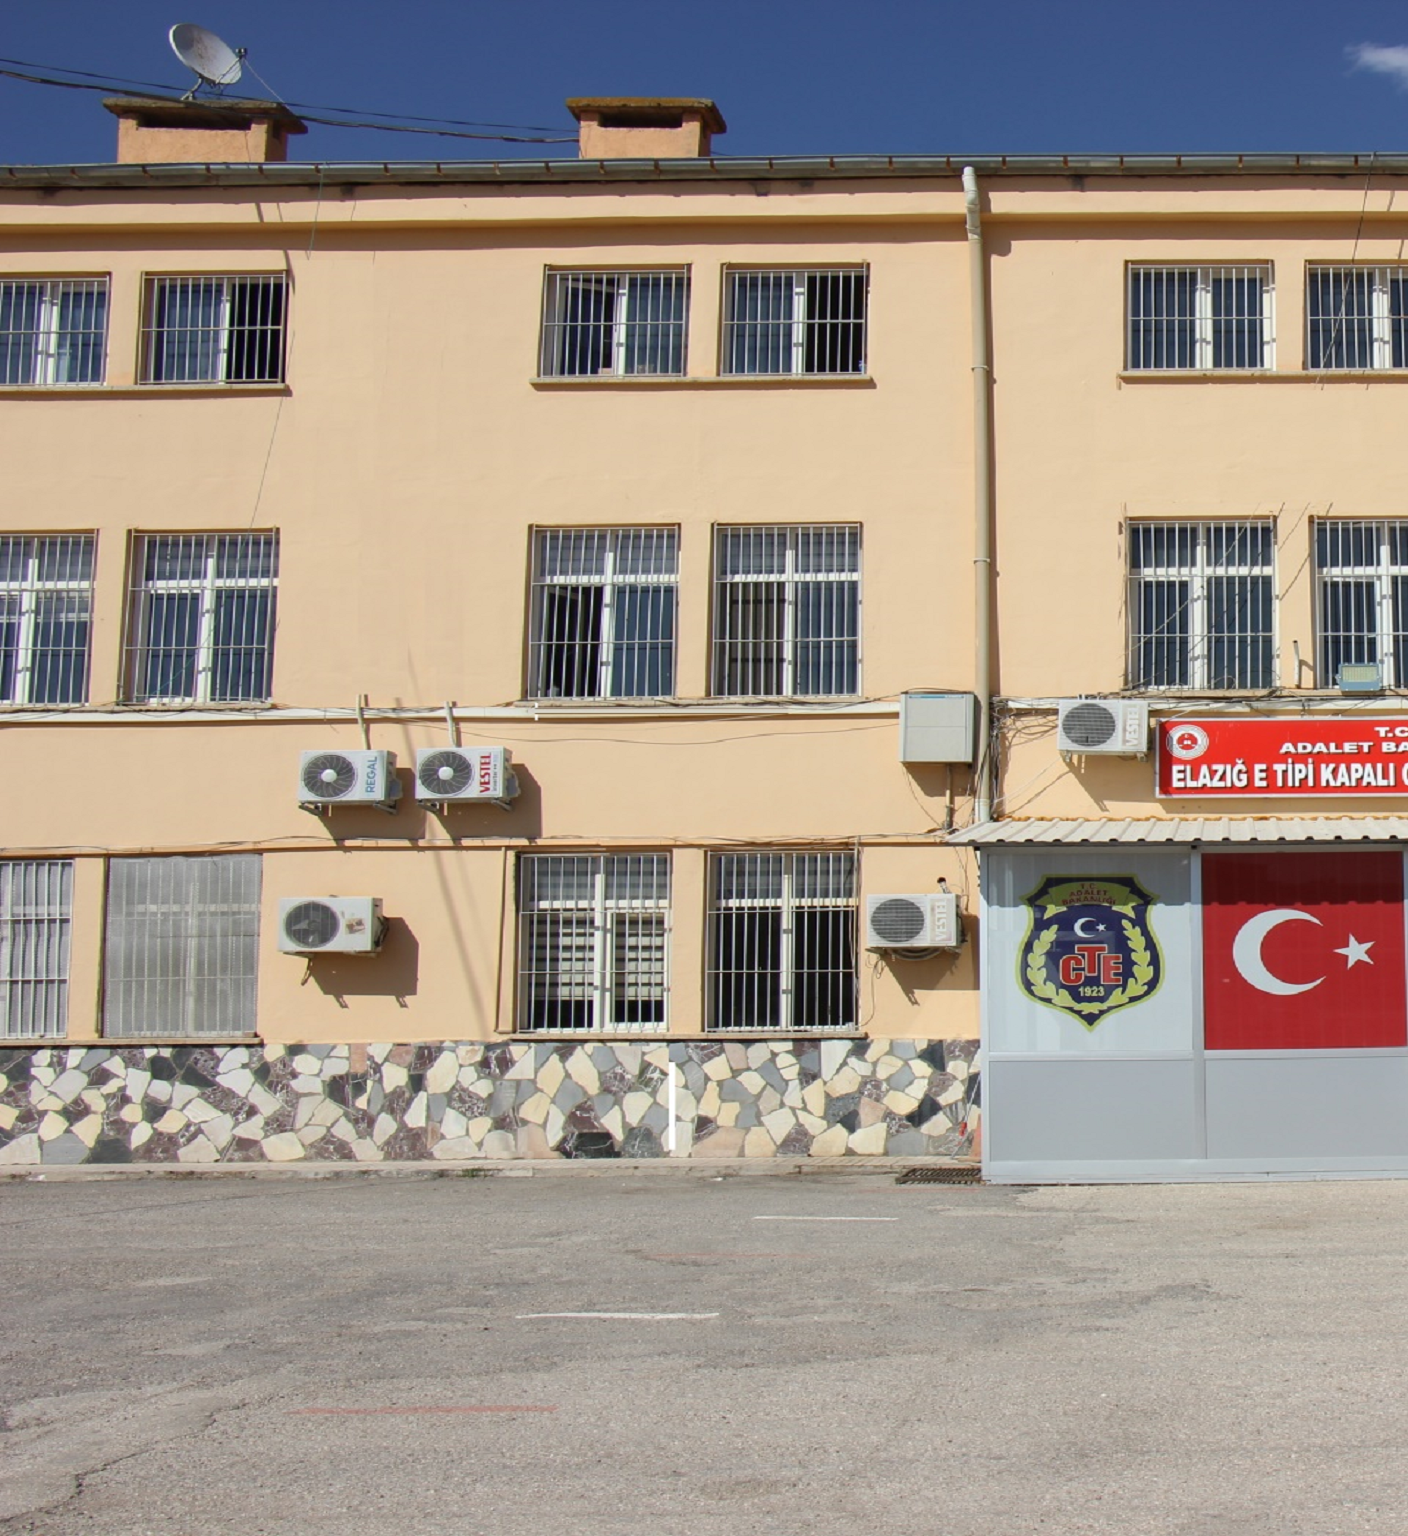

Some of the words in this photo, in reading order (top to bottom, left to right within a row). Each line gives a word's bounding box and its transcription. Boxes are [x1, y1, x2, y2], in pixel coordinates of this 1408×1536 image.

[1125, 706, 1139, 746] VESTEL
[1279, 742, 1374, 754] ADALET
[365, 756, 378, 793] REGAL
[479, 751, 492, 793] VESTEL
[1171, 757, 1249, 788] ELAZIĞ
[1253, 763, 1268, 788] E
[1272, 757, 1315, 788] TİPİ
[1320, 762, 1396, 787] KAPALI
[1069, 889, 1108, 897] ADALET
[935, 898, 947, 941] VESTEL
[1059, 943, 1123, 986] CTE
[1077, 985, 1105, 997] 1923
